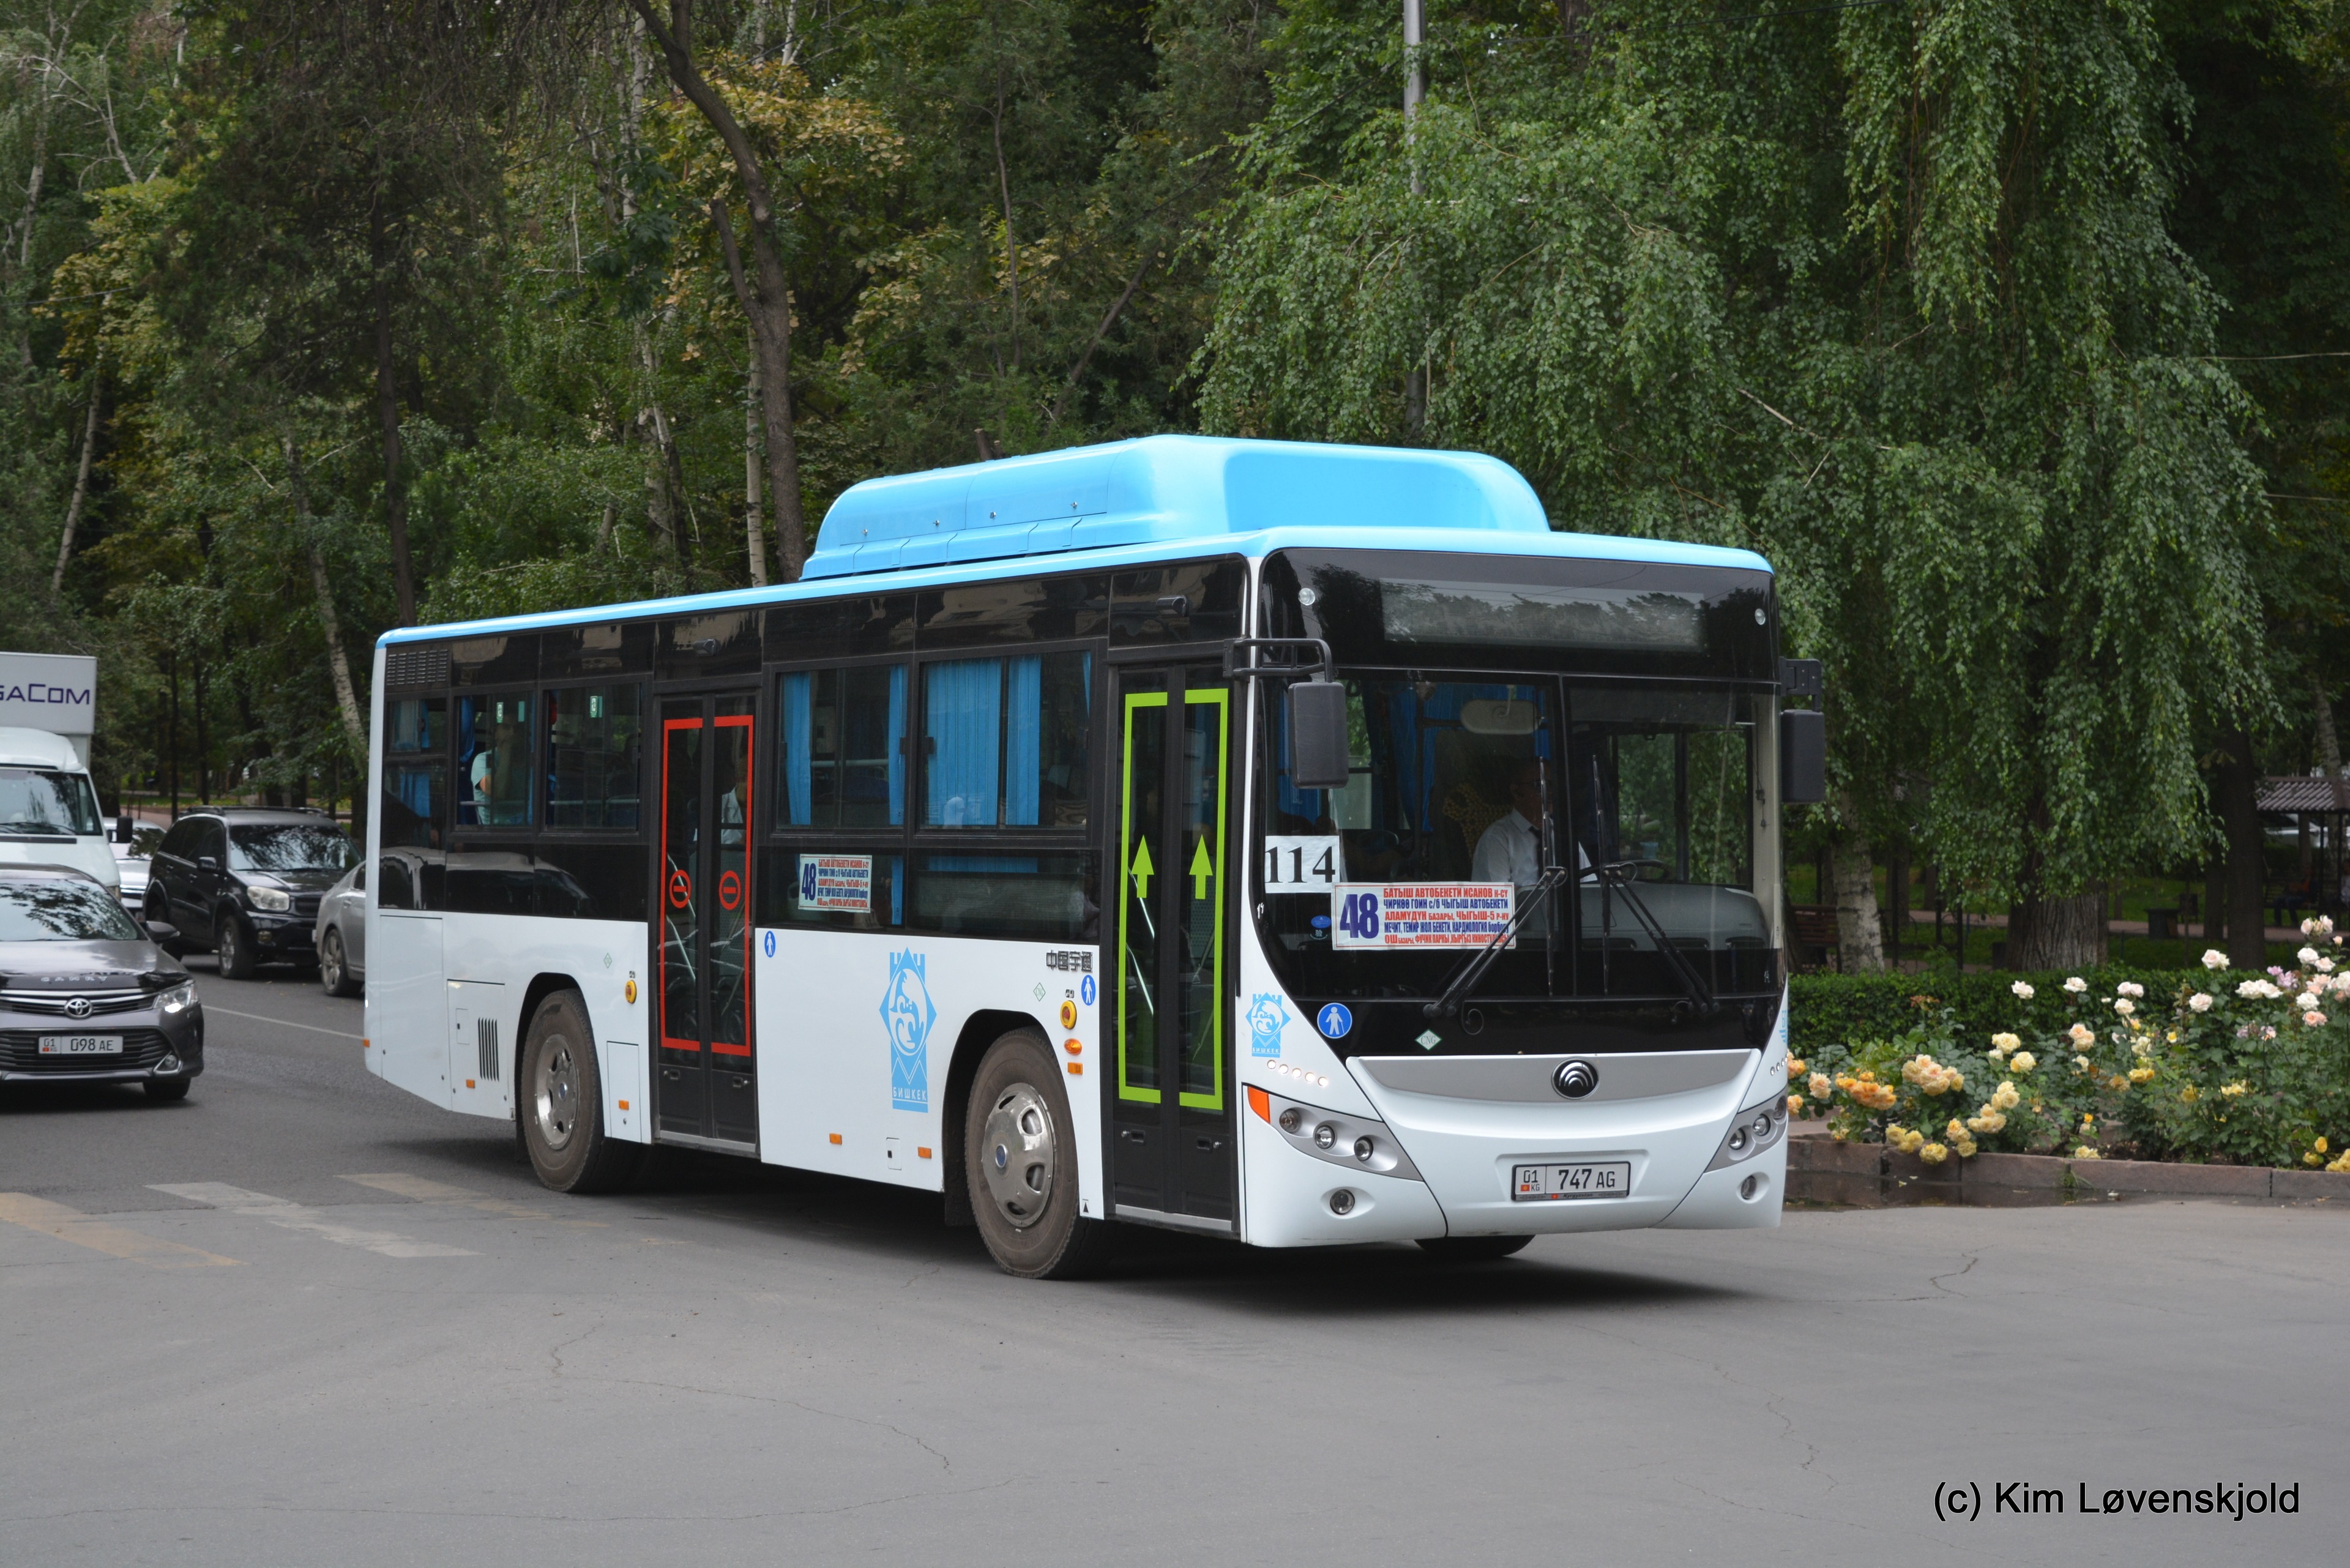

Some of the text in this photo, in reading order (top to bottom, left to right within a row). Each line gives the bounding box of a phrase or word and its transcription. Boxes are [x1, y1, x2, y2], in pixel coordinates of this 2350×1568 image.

[1265, 846, 1335, 883] 114
[802, 863, 816, 900] 48
[1384, 888, 1414, 898] БАТЫШ
[1415, 888, 1461, 898] АВТОБЕКЕТИ
[1463, 887, 1493, 898] ИСАНОВ
[1411, 898, 1427, 909] ГОИН
[1429, 898, 1440, 909] с/б
[1441, 898, 1469, 909] ЧЫГЫШ
[1470, 898, 1508, 909] АВТОБЕКЕТИ
[1340, 893, 1379, 939] 48
[1457, 911, 1494, 920] ЧЫГЫШ-5
[1403, 922, 1419, 933] ТЕМИР
[1420, 922, 1431, 932] ЖОЛ
[1452, 922, 1487, 933] КАРДИОЛОГИЯ
[1385, 935, 1398, 944] ОШ
[44, 1038, 55, 1047] 01
[70, 1038, 113, 1051] 098 AE
[1420, 1036, 1436, 1045] CNG
[893, 1087, 927, 1101] БИШКЕК
[1523, 1170, 1538, 1183] 01
[1559, 1168, 1615, 1190] 747 AG
